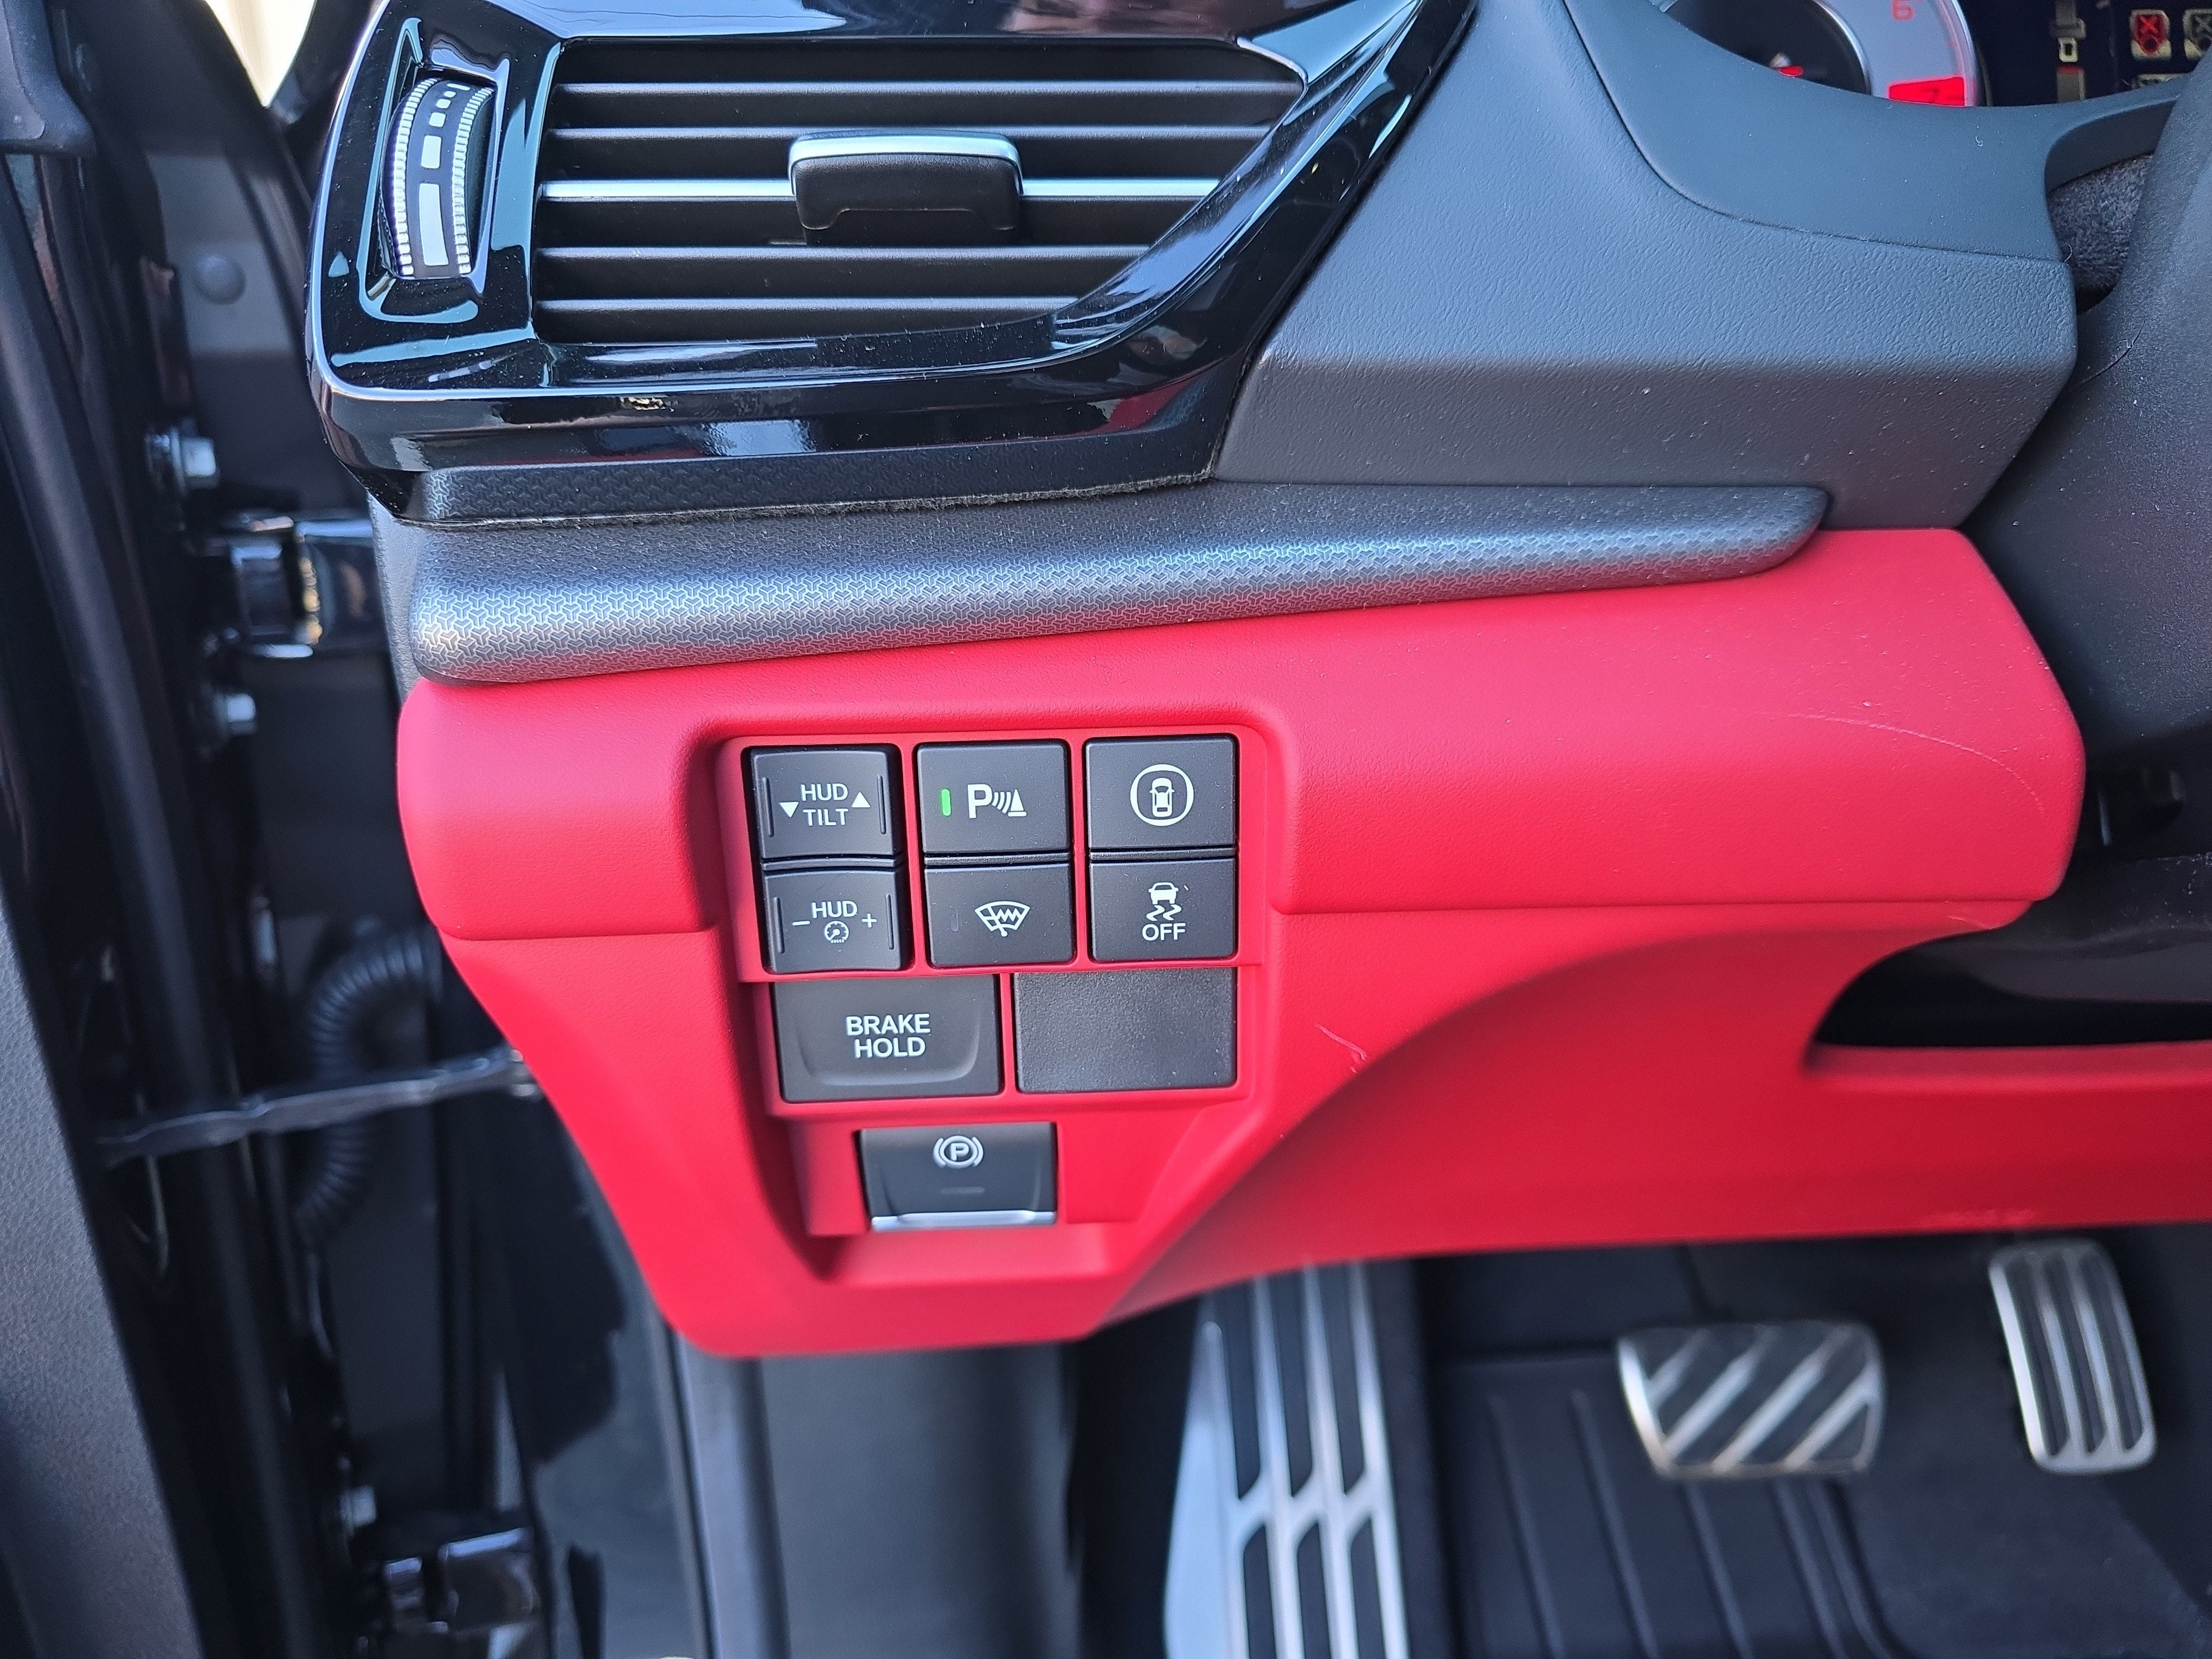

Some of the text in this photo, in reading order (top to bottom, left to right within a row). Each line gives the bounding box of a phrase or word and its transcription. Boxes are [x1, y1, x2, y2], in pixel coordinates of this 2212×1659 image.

[801, 783, 848, 801] HUD
[803, 808, 849, 826] TILT
[812, 901, 858, 918] HUD
[1142, 923, 1186, 941] OFF
[846, 1013, 931, 1036] BRAKE
[854, 1037, 925, 1058] HOLD
